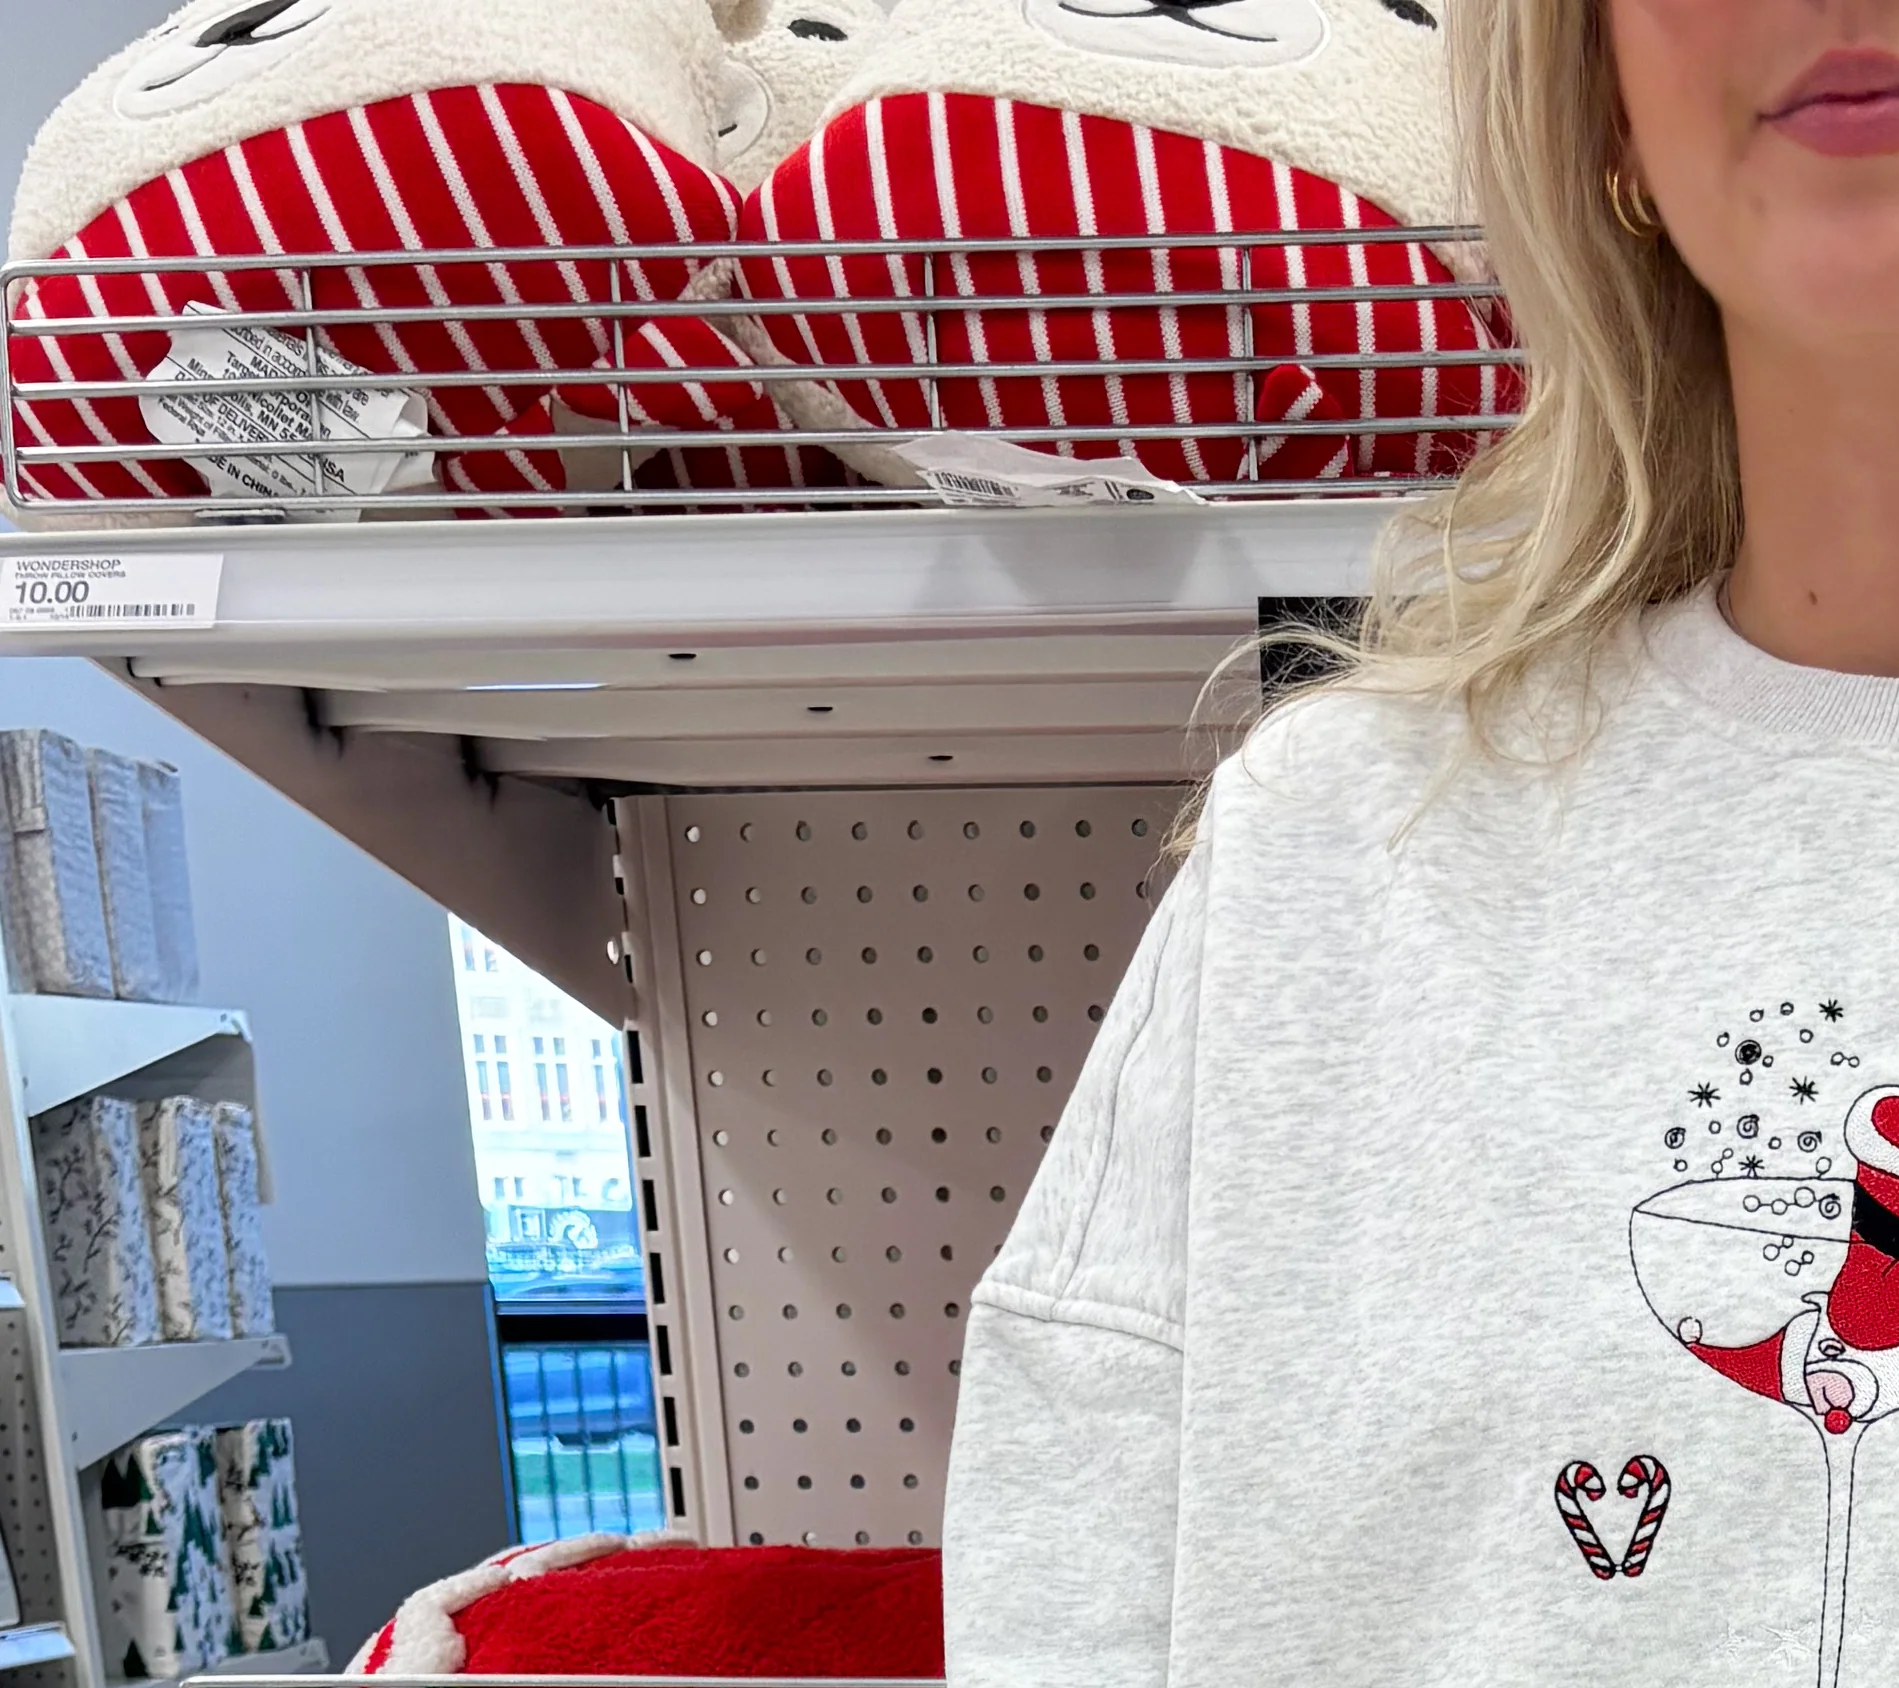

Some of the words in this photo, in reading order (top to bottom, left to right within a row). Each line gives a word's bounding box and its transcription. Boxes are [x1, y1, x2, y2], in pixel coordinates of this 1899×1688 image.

[256, 411, 278, 431] MN
[16, 559, 121, 571] WONDERSHOP
[15, 580, 90, 605] 10.00
